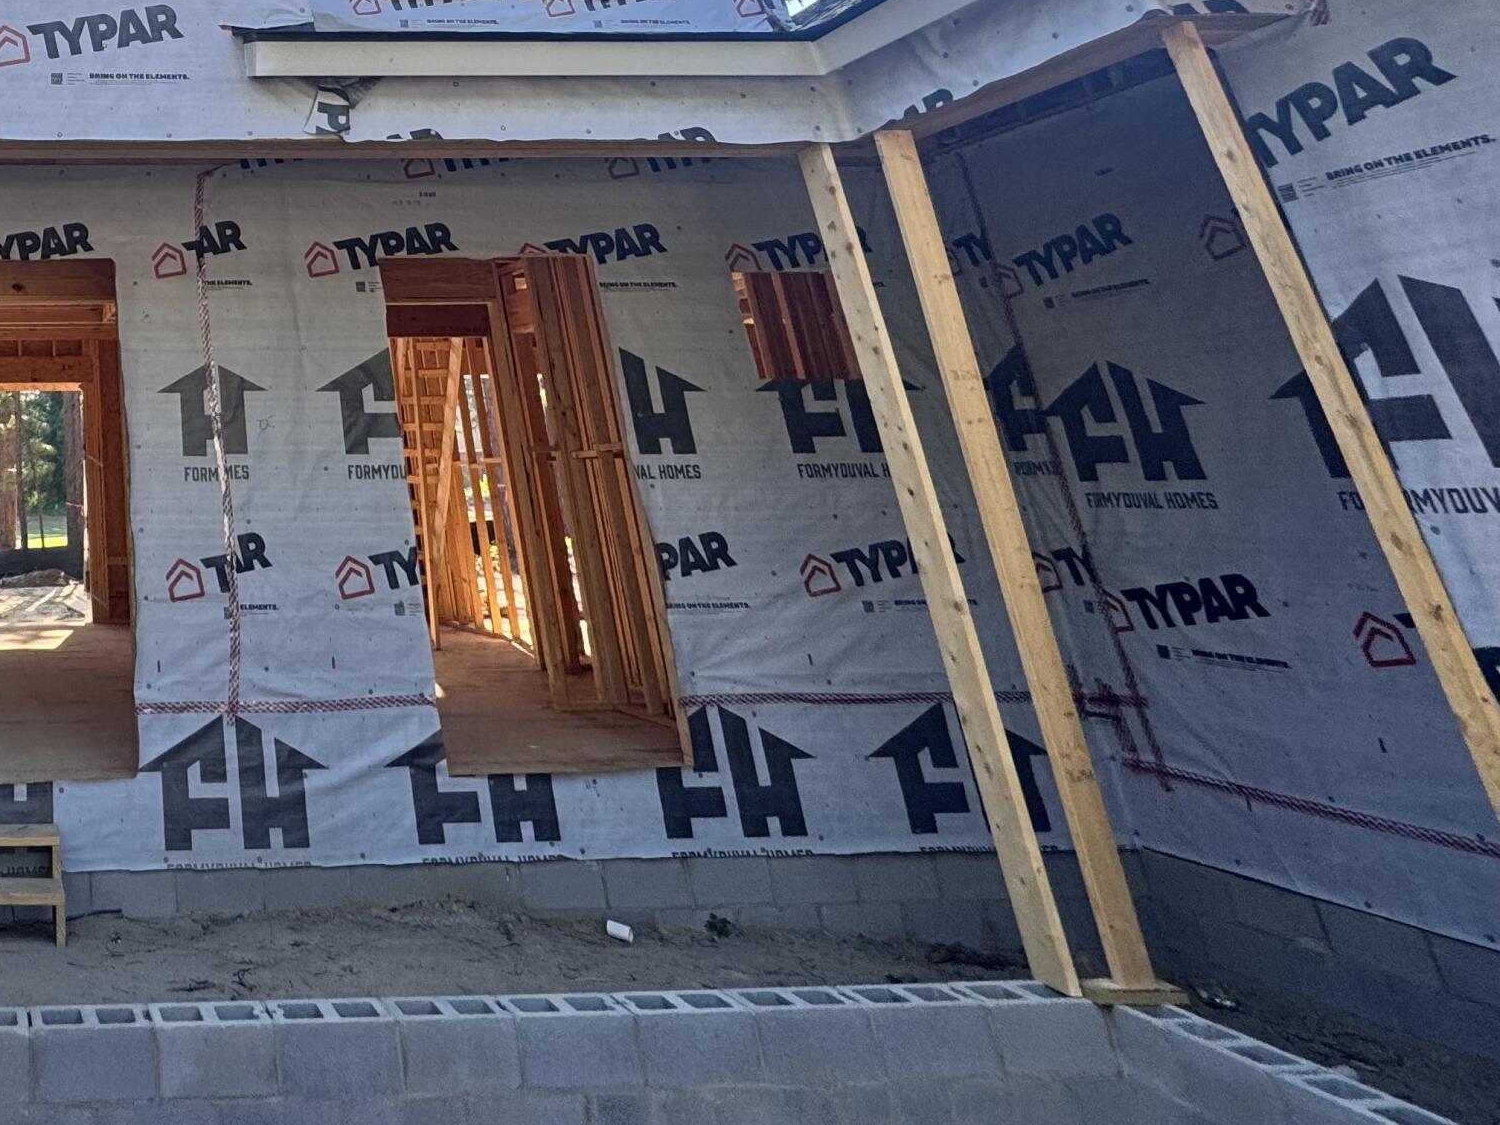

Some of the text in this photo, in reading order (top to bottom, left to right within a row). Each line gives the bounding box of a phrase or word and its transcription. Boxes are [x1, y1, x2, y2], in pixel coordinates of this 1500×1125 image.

[26, 4, 184, 59] TYPAR
[1325, 134, 1496, 181] BRING ON THE ELEMENTS.
[333, 222, 460, 270] TYPAR
[1012, 213, 1133, 287] TYPAR
[658, 464, 701, 479] HOMES
[797, 462, 879, 478] FORMYDUVAL
[1166, 492, 1219, 510] HOMES
[1120, 573, 1271, 630] TYPAR
